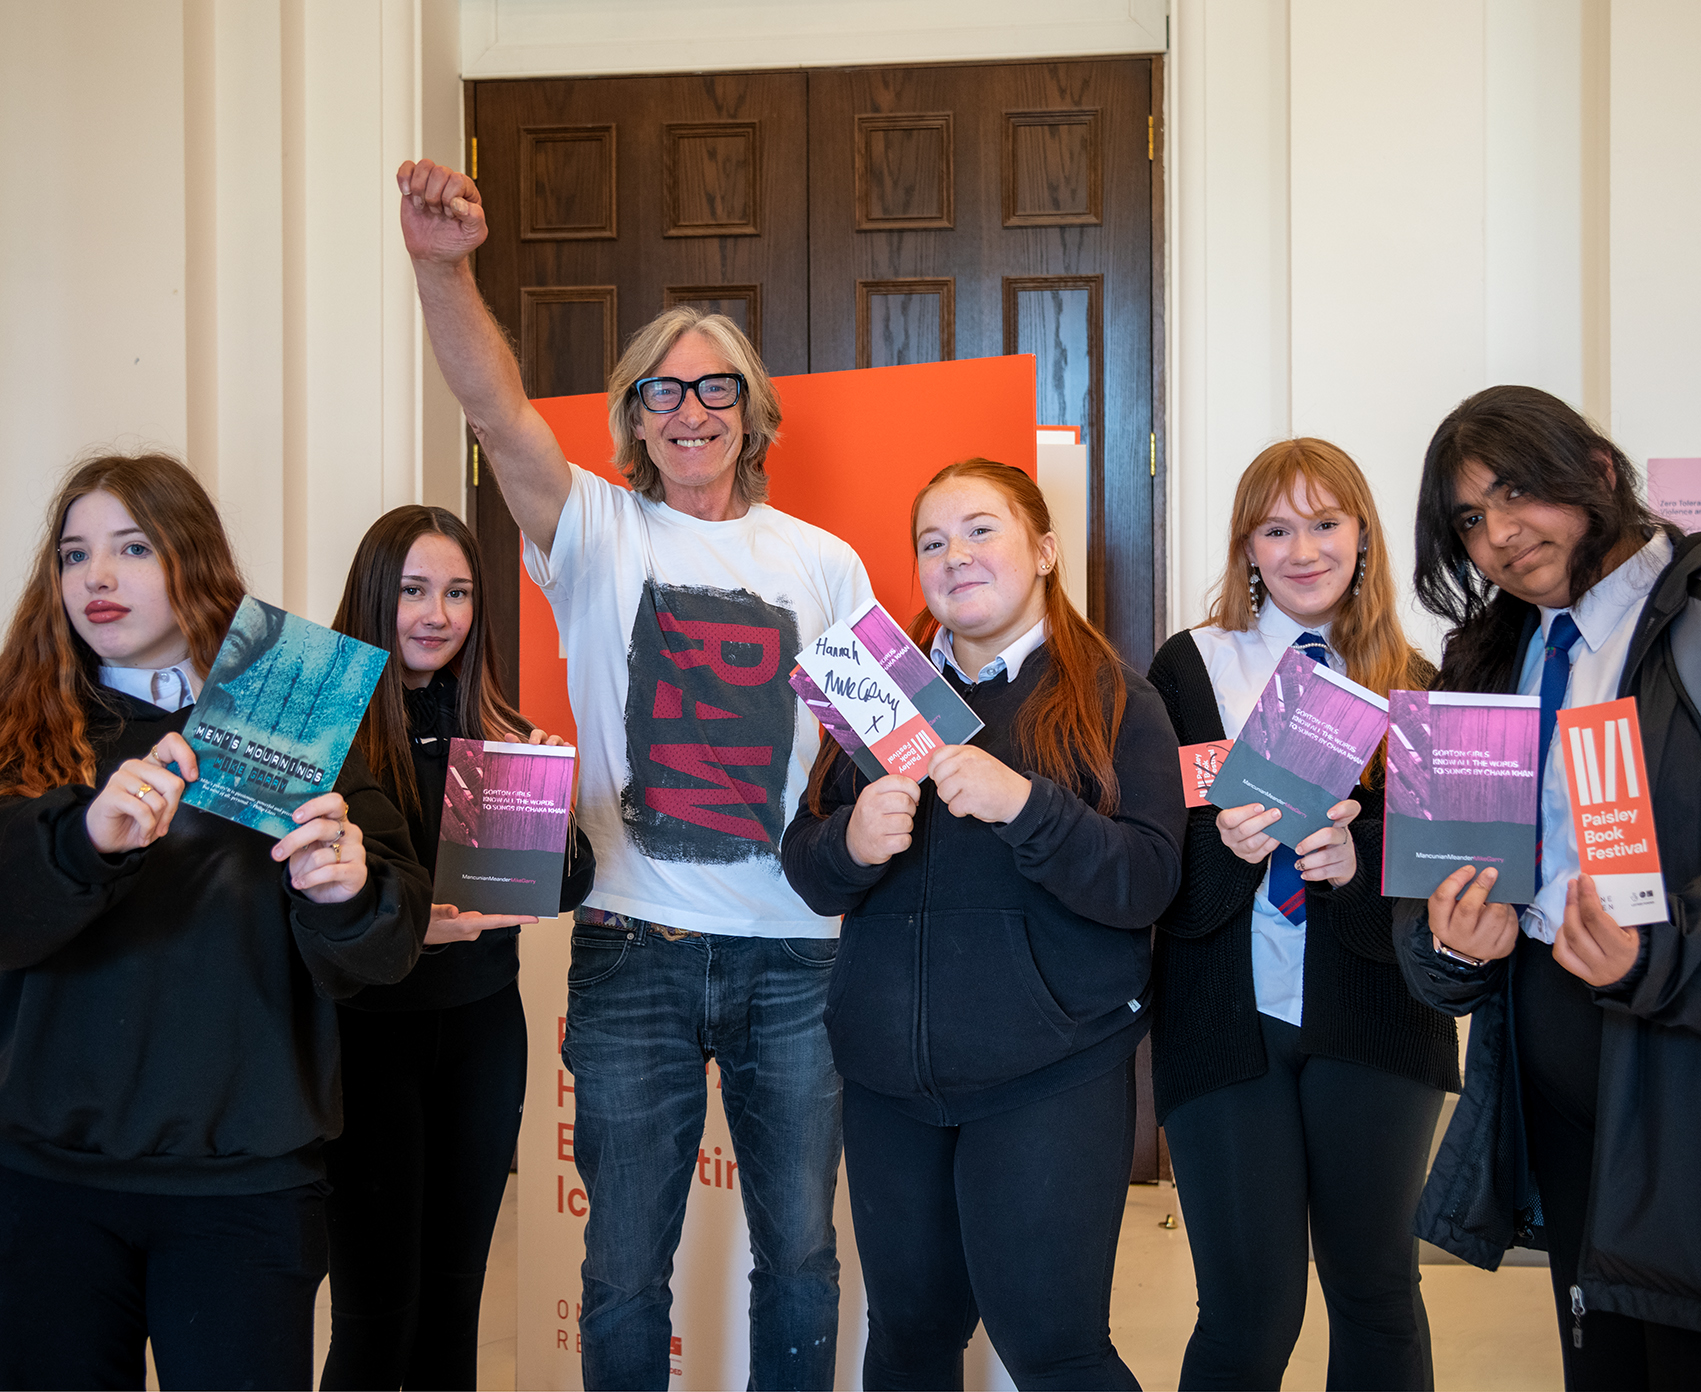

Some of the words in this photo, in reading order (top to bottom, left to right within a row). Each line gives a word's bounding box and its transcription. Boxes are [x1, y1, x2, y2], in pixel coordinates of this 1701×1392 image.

[815, 637, 861, 665] Hannah
[1295, 708, 1321, 725] GORTON
[1288, 722, 1298, 730] TO
[1297, 727, 1319, 741] SONGS
[1326, 742, 1347, 756] CHAKA
[1346, 752, 1365, 766] KHAN
[1321, 731, 1334, 741] THE
[1334, 737, 1357, 753] WORDS
[196, 725, 240, 750] MEN'S
[245, 744, 323, 782] MOURNINGS
[887, 741, 912, 765] Festival
[897, 753, 922, 774] Paisley
[900, 747, 917, 763] Book
[215, 757, 246, 775] MIKE
[250, 770, 287, 790] GARRY
[1581, 809, 1637, 827] Paisley
[1584, 826, 1624, 844] Book
[1586, 839, 1648, 860] Festival
